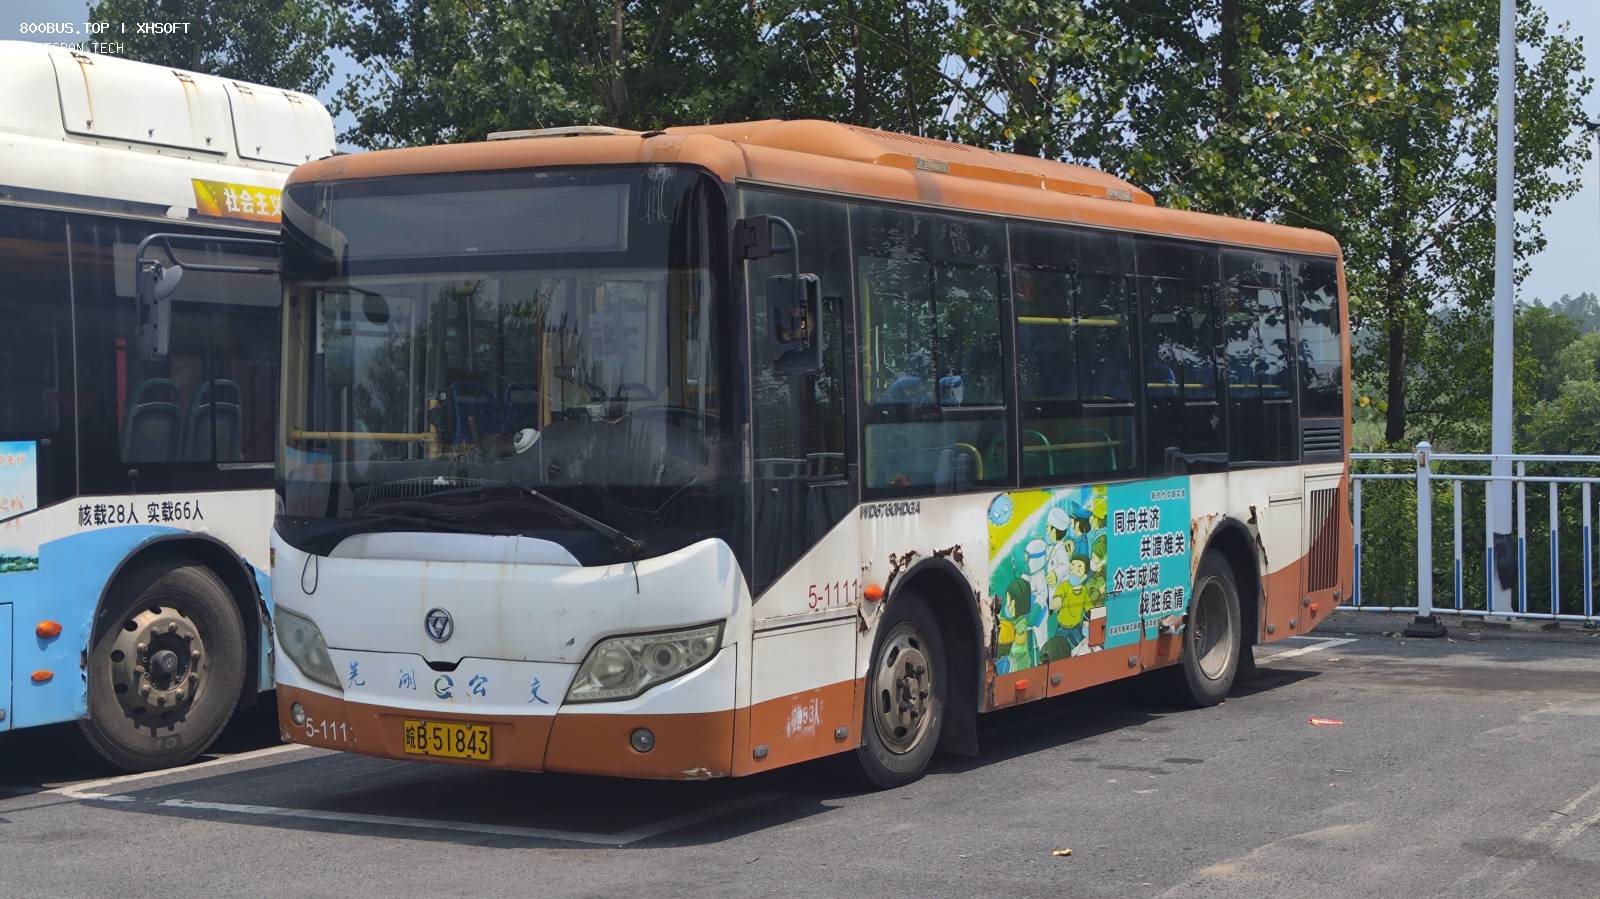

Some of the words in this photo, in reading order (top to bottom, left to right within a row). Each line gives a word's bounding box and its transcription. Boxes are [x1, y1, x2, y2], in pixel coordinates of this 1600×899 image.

[78, 503, 139, 527] 核载28人
[147, 499, 204, 522] 实载66人
[1113, 506, 1160, 534] 同舟共济
[1140, 533, 1185, 560] 共渡难关
[1113, 564, 1160, 593] 众志成城
[808, 578, 858, 609] 5-1111
[1139, 587, 1184, 617] 战胜疫情
[306, 717, 357, 743] 5-111
